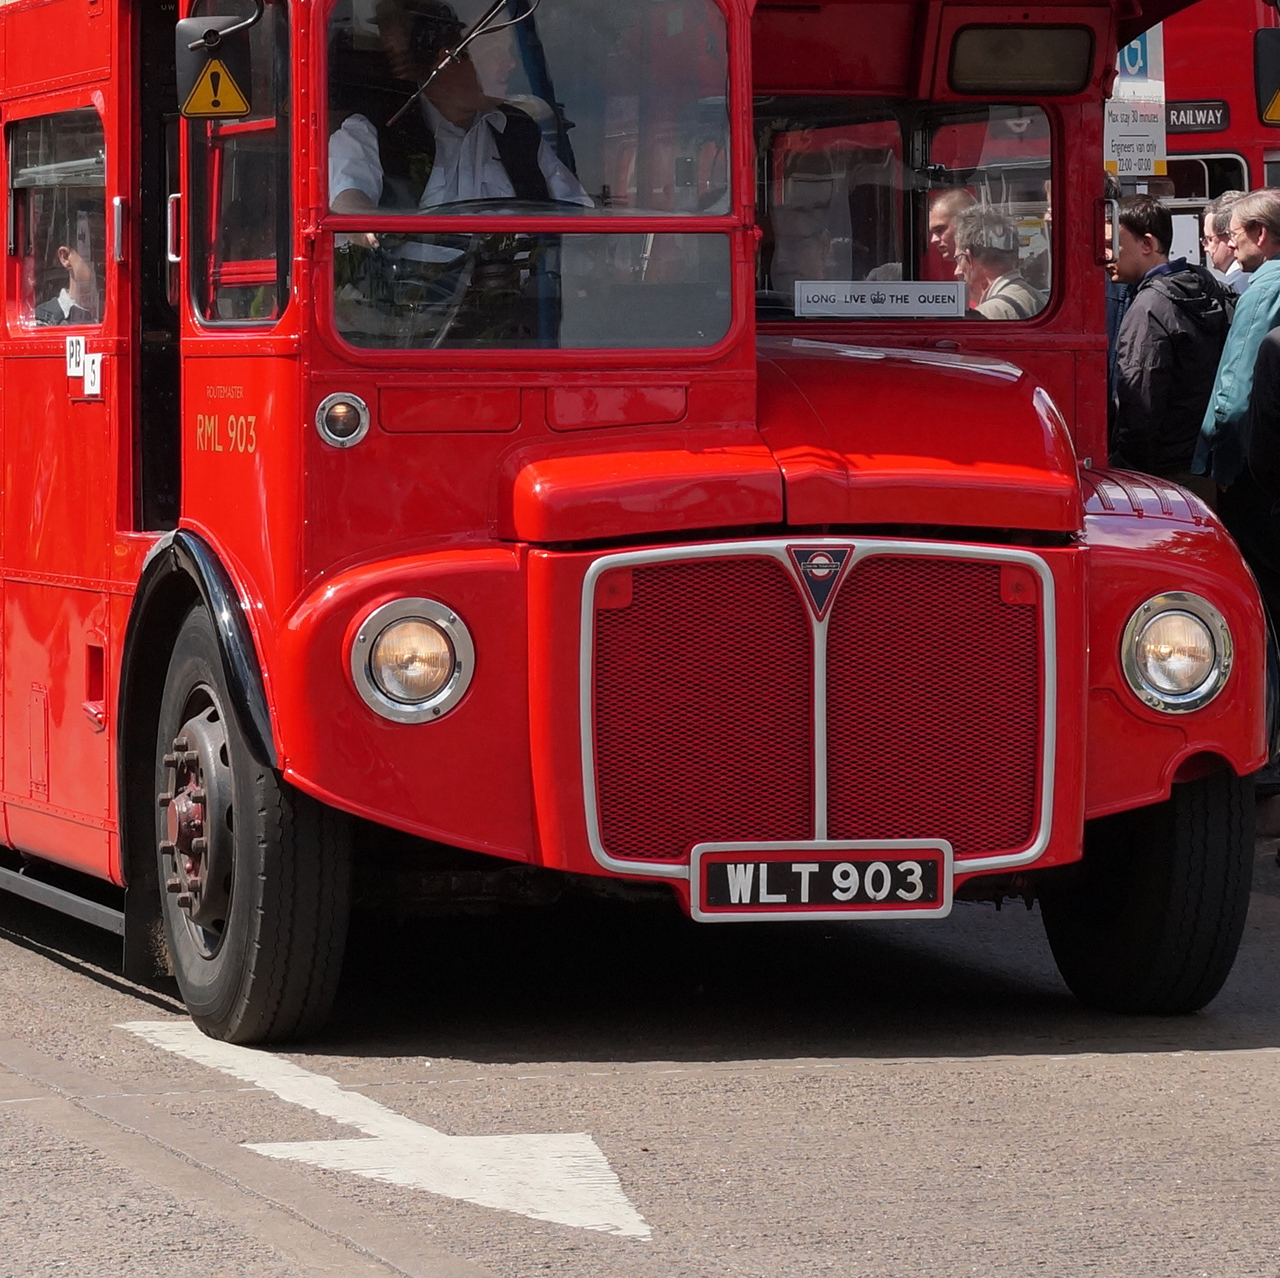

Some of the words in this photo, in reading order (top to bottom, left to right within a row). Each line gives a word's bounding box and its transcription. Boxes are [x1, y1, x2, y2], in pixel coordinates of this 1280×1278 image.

[1107, 110, 1119, 123] Max
[1120, 112, 1130, 127] stay
[1131, 110, 1139, 123] 30
[1139, 110, 1159, 123] minutes
[1170, 109, 1223, 126] RAILWAY
[1111, 139, 1135, 157] Engineers
[1136, 142, 1145, 152] van
[1146, 140, 1157, 156] only
[806, 293, 837, 305] LONG
[844, 293, 867, 305] LIVE
[889, 293, 910, 305] THE
[918, 293, 956, 306] QUEEN
[68, 338, 83, 369] PB
[89, 358, 97, 388] 5
[206, 385, 244, 399] ROUTEMASTER
[196, 413, 223, 452] RML
[227, 414, 257, 453] 903
[726, 863, 820, 904] WLT
[831, 861, 924, 901] 903
